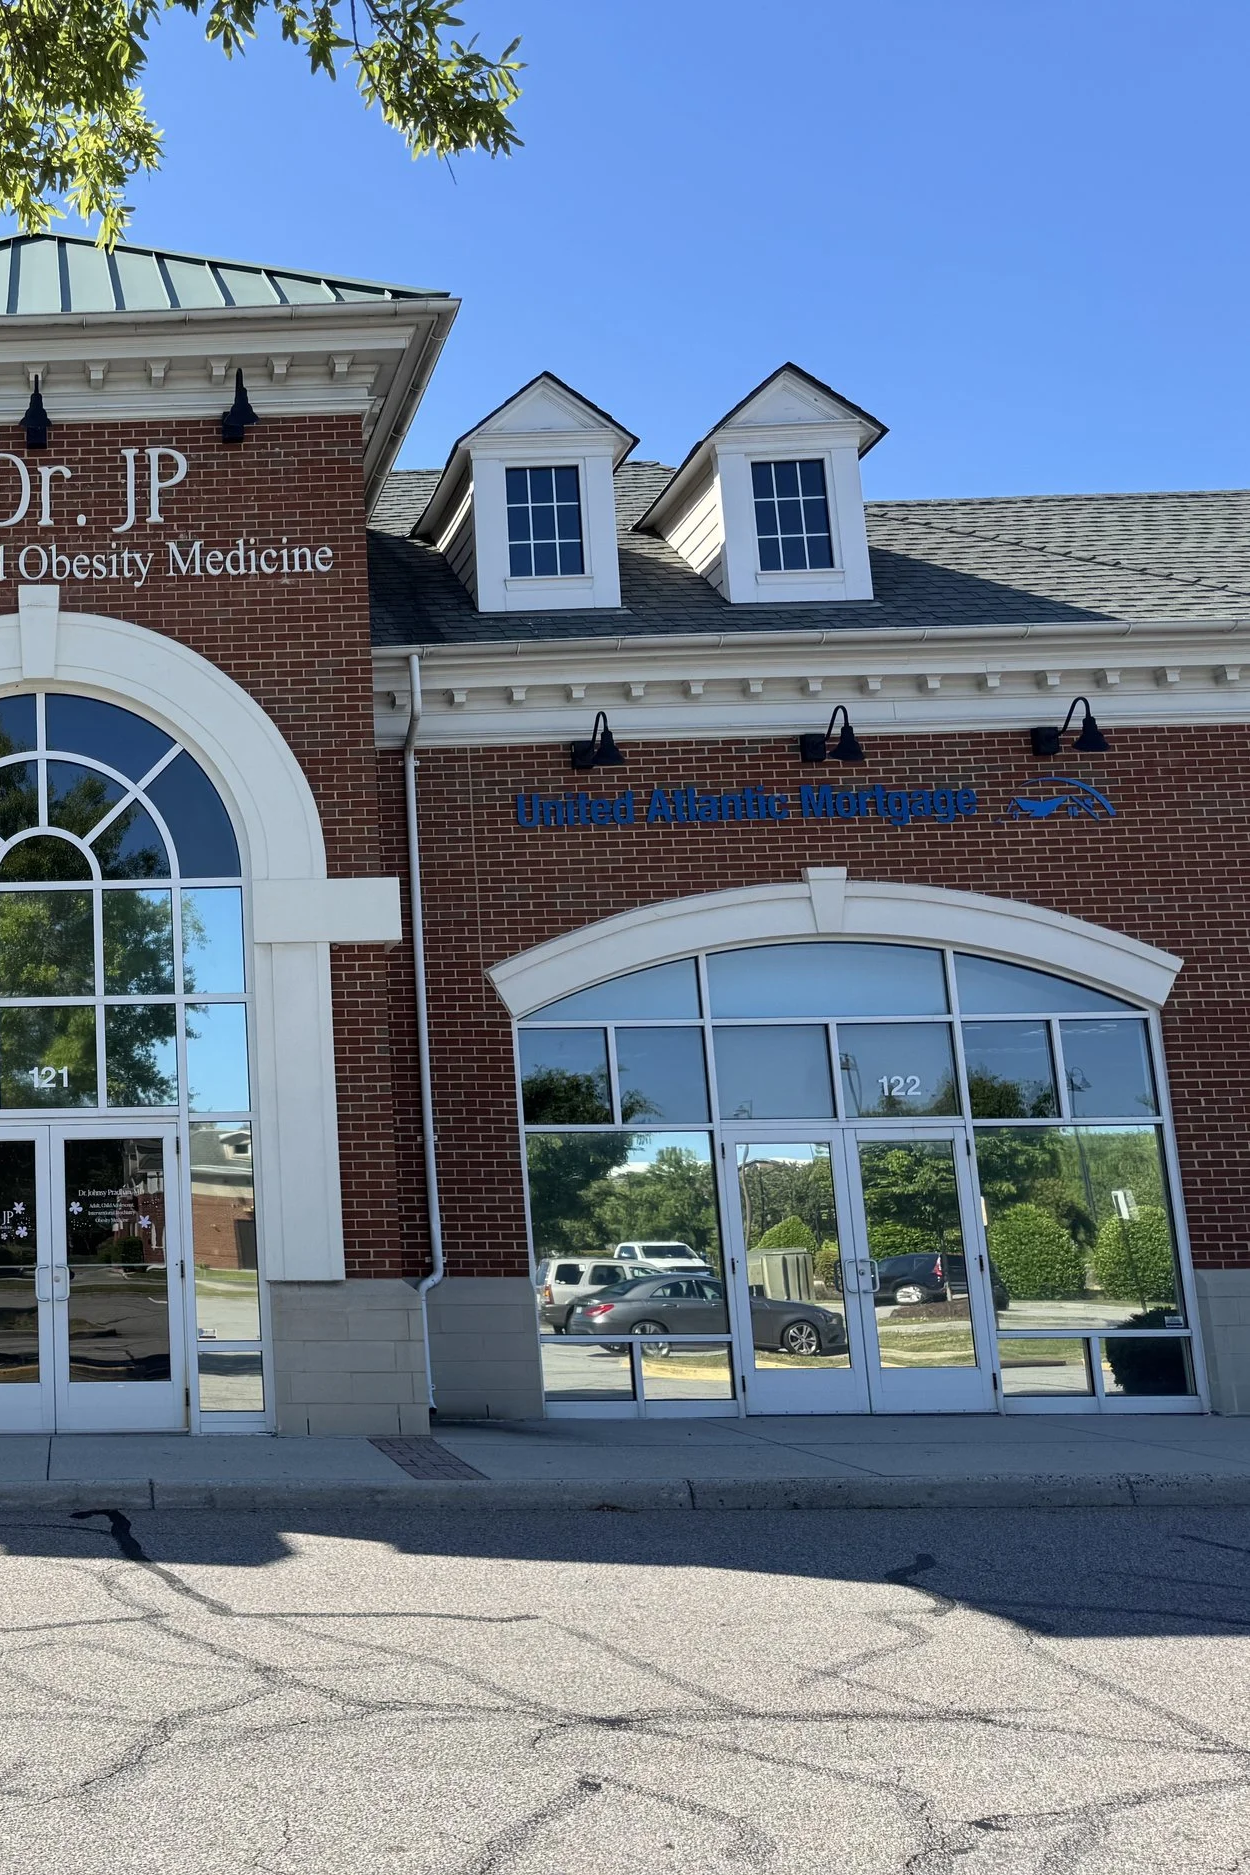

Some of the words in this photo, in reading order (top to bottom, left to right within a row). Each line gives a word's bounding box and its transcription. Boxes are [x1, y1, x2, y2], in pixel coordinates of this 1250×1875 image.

[111, 447, 189, 533] JP
[18, 541, 155, 588] Obesity
[165, 536, 334, 577] Medicine
[516, 789, 635, 828] United
[647, 785, 789, 823] Atlantic
[799, 783, 978, 826] Mortgage
[28, 1065, 69, 1088] 121
[878, 1075, 922, 1096] 122
[78, 1189, 87, 1197] Dr.
[1, 1210, 14, 1226] JP
